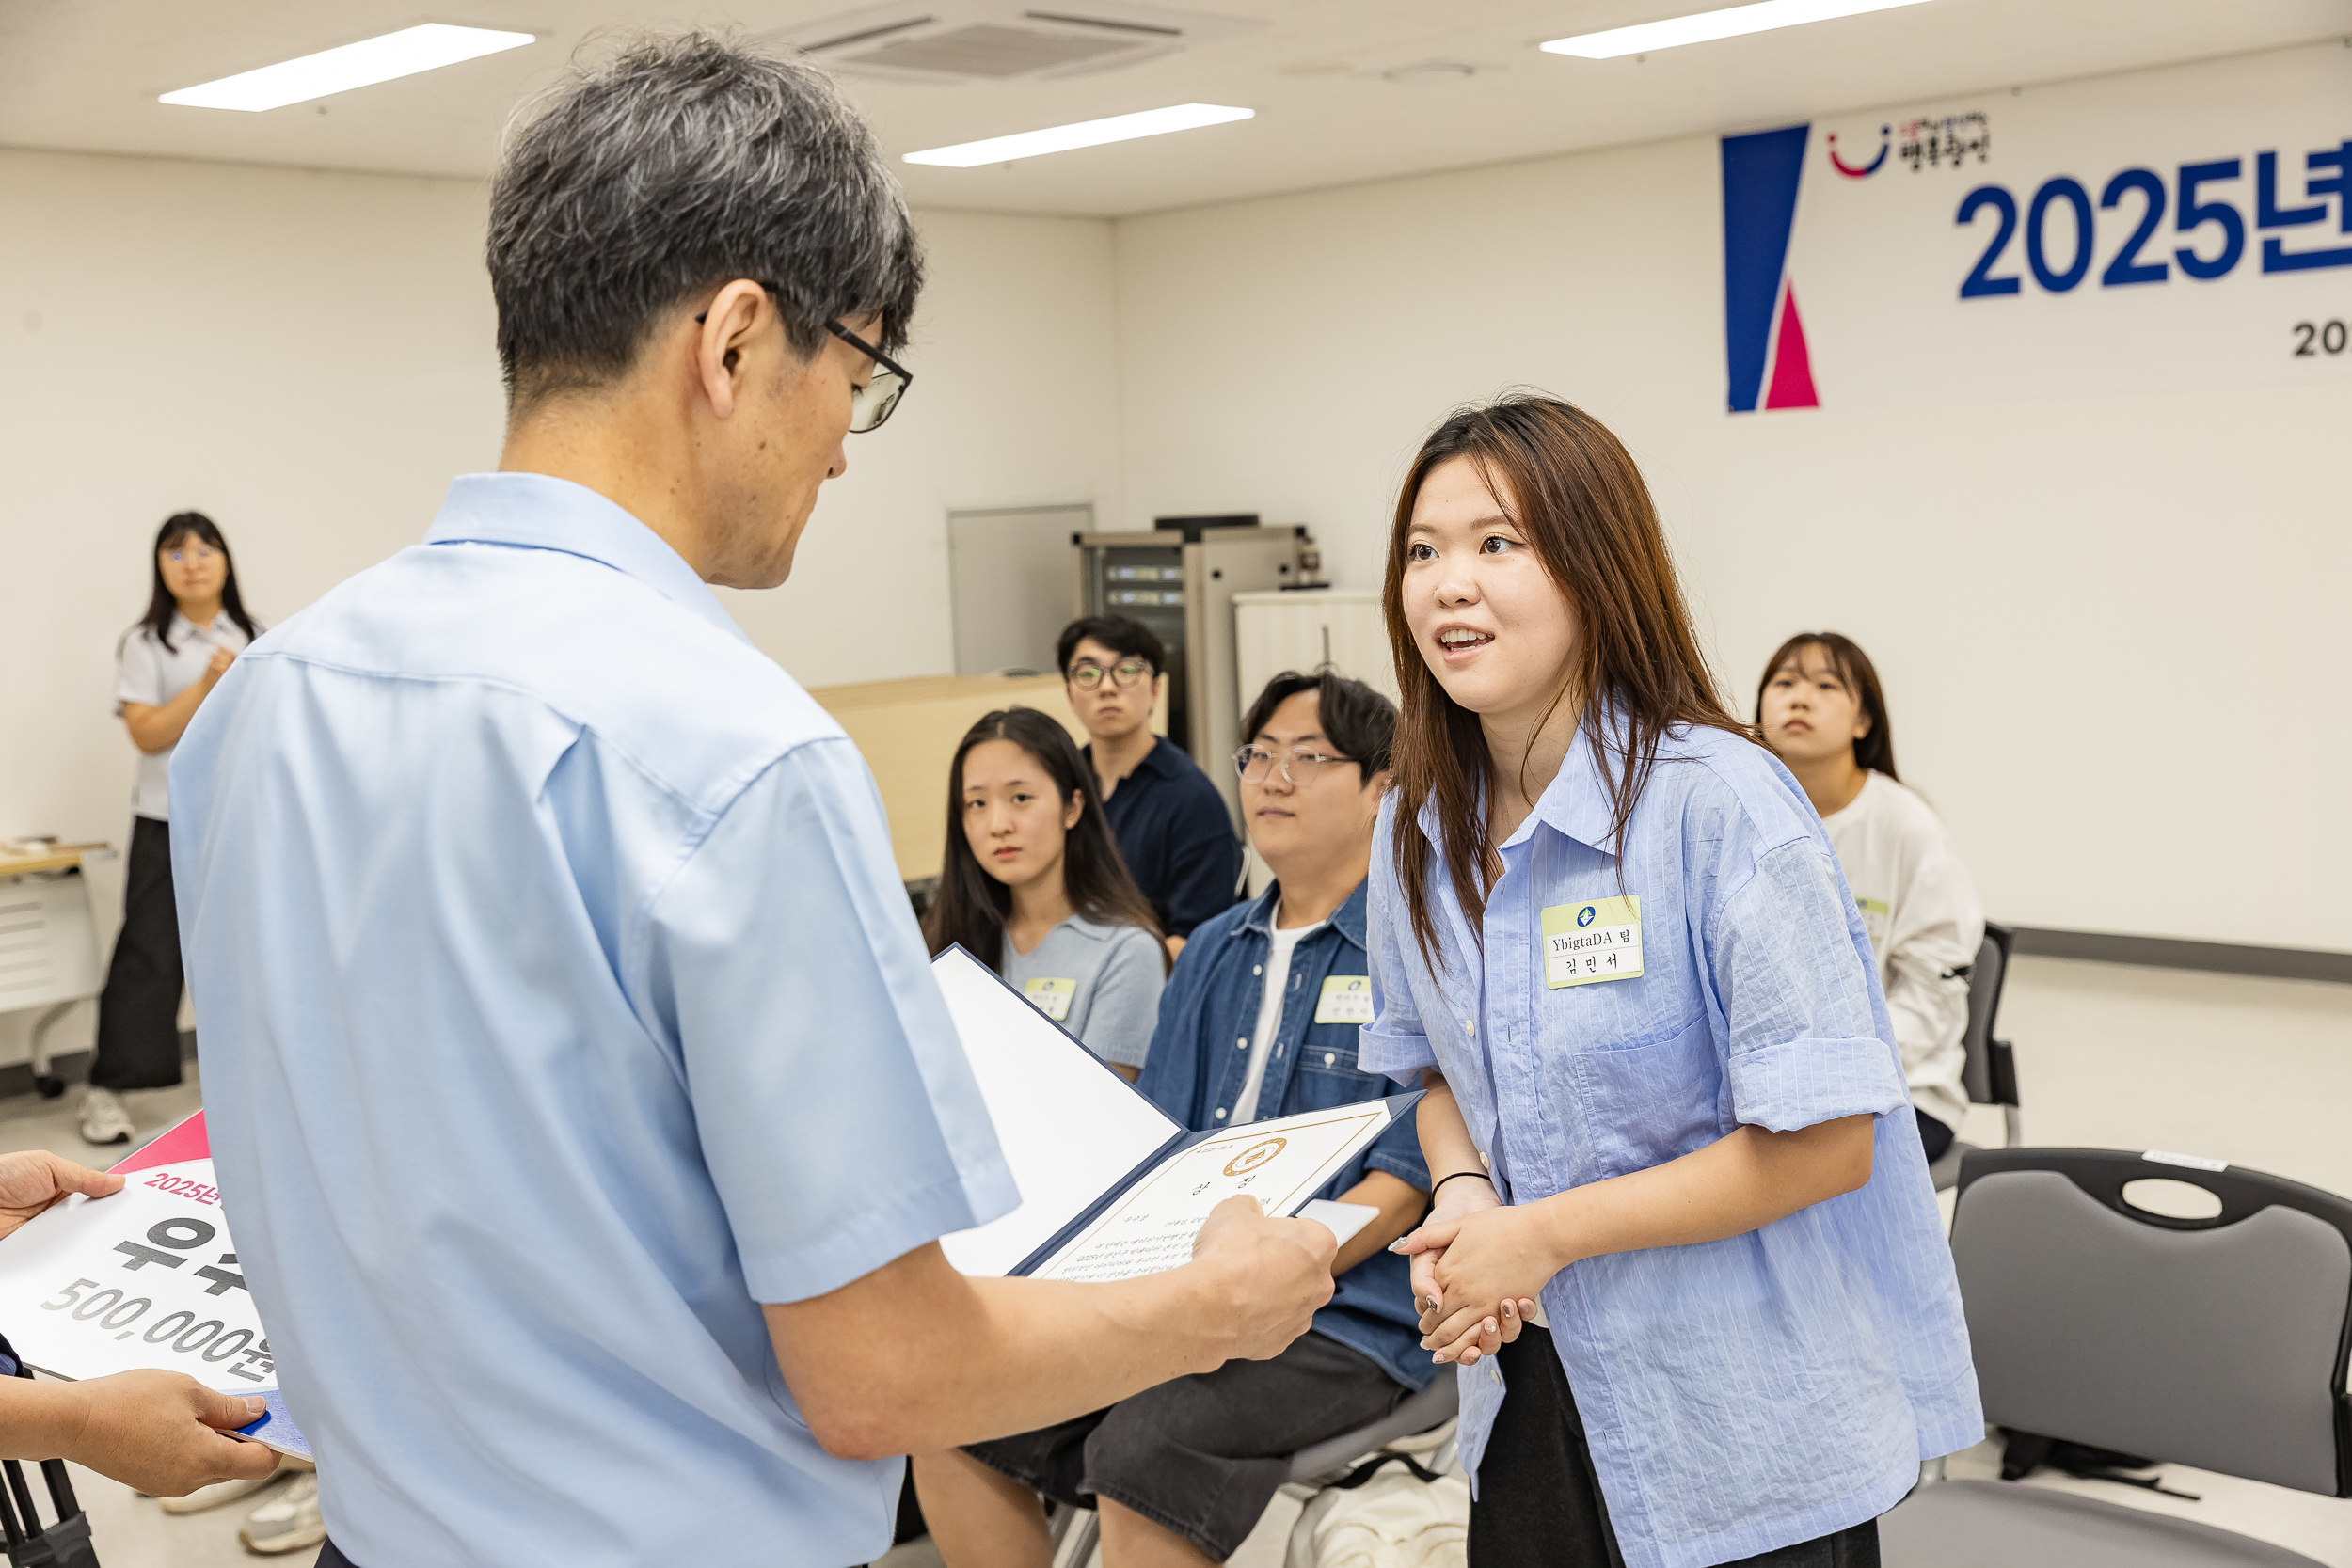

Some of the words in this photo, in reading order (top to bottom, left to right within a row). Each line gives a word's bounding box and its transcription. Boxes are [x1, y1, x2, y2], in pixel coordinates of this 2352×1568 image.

[1954, 138, 2352, 301] 2025년
[2293, 320, 2352, 356] 20
[1552, 931, 1613, 952] YbigtaDA
[1619, 929, 1629, 943] 팀
[143, 1172, 222, 1206] 2025년
[40, 1277, 276, 1383] 500,000원
